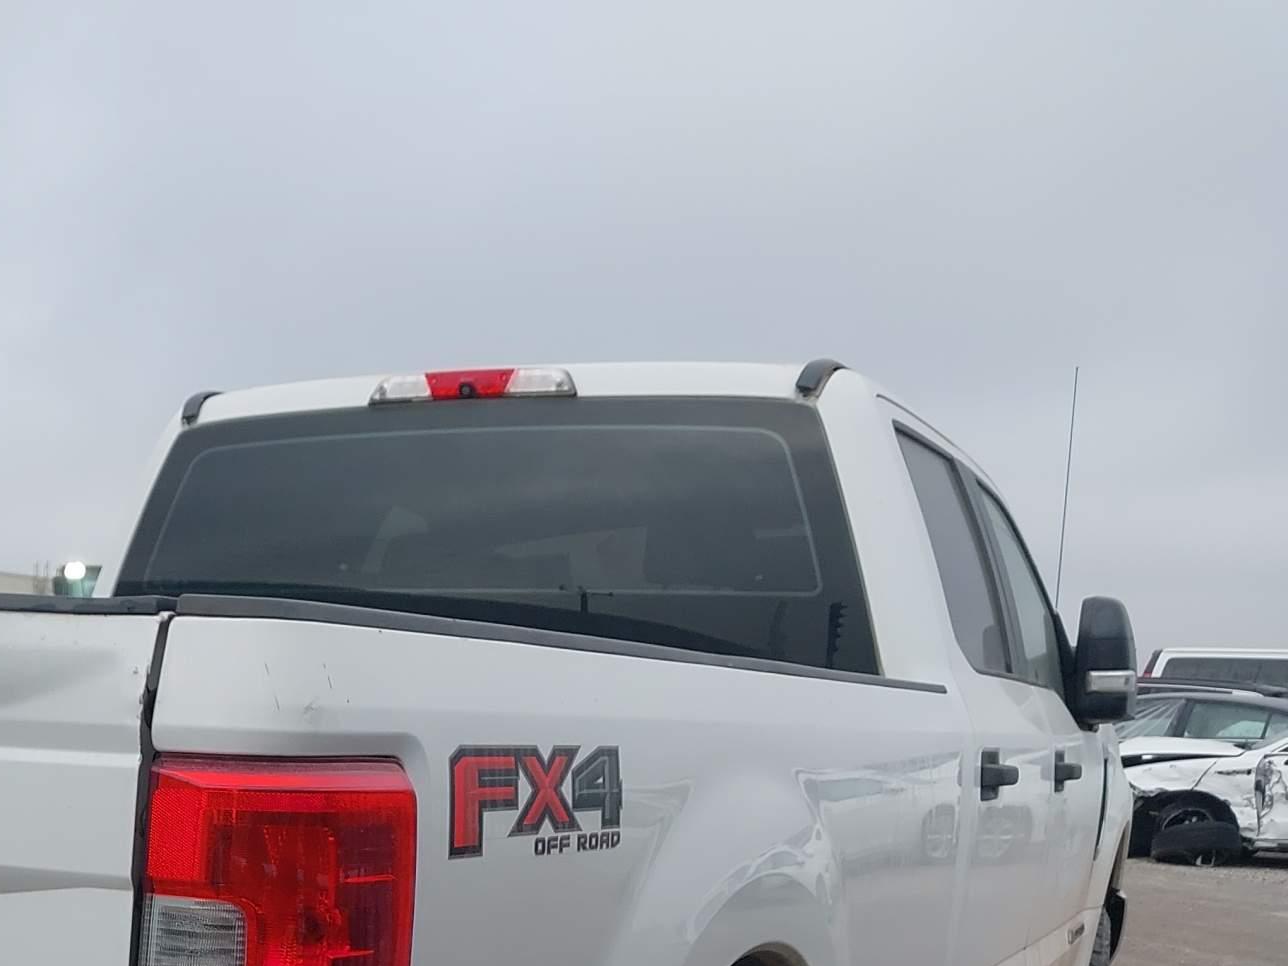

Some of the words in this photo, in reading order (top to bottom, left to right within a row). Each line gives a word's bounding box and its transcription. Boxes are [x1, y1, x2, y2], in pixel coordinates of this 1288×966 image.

[449, 745, 623, 860] FX4
[534, 837, 570, 856] OFF
[577, 831, 621, 852] ROAD
